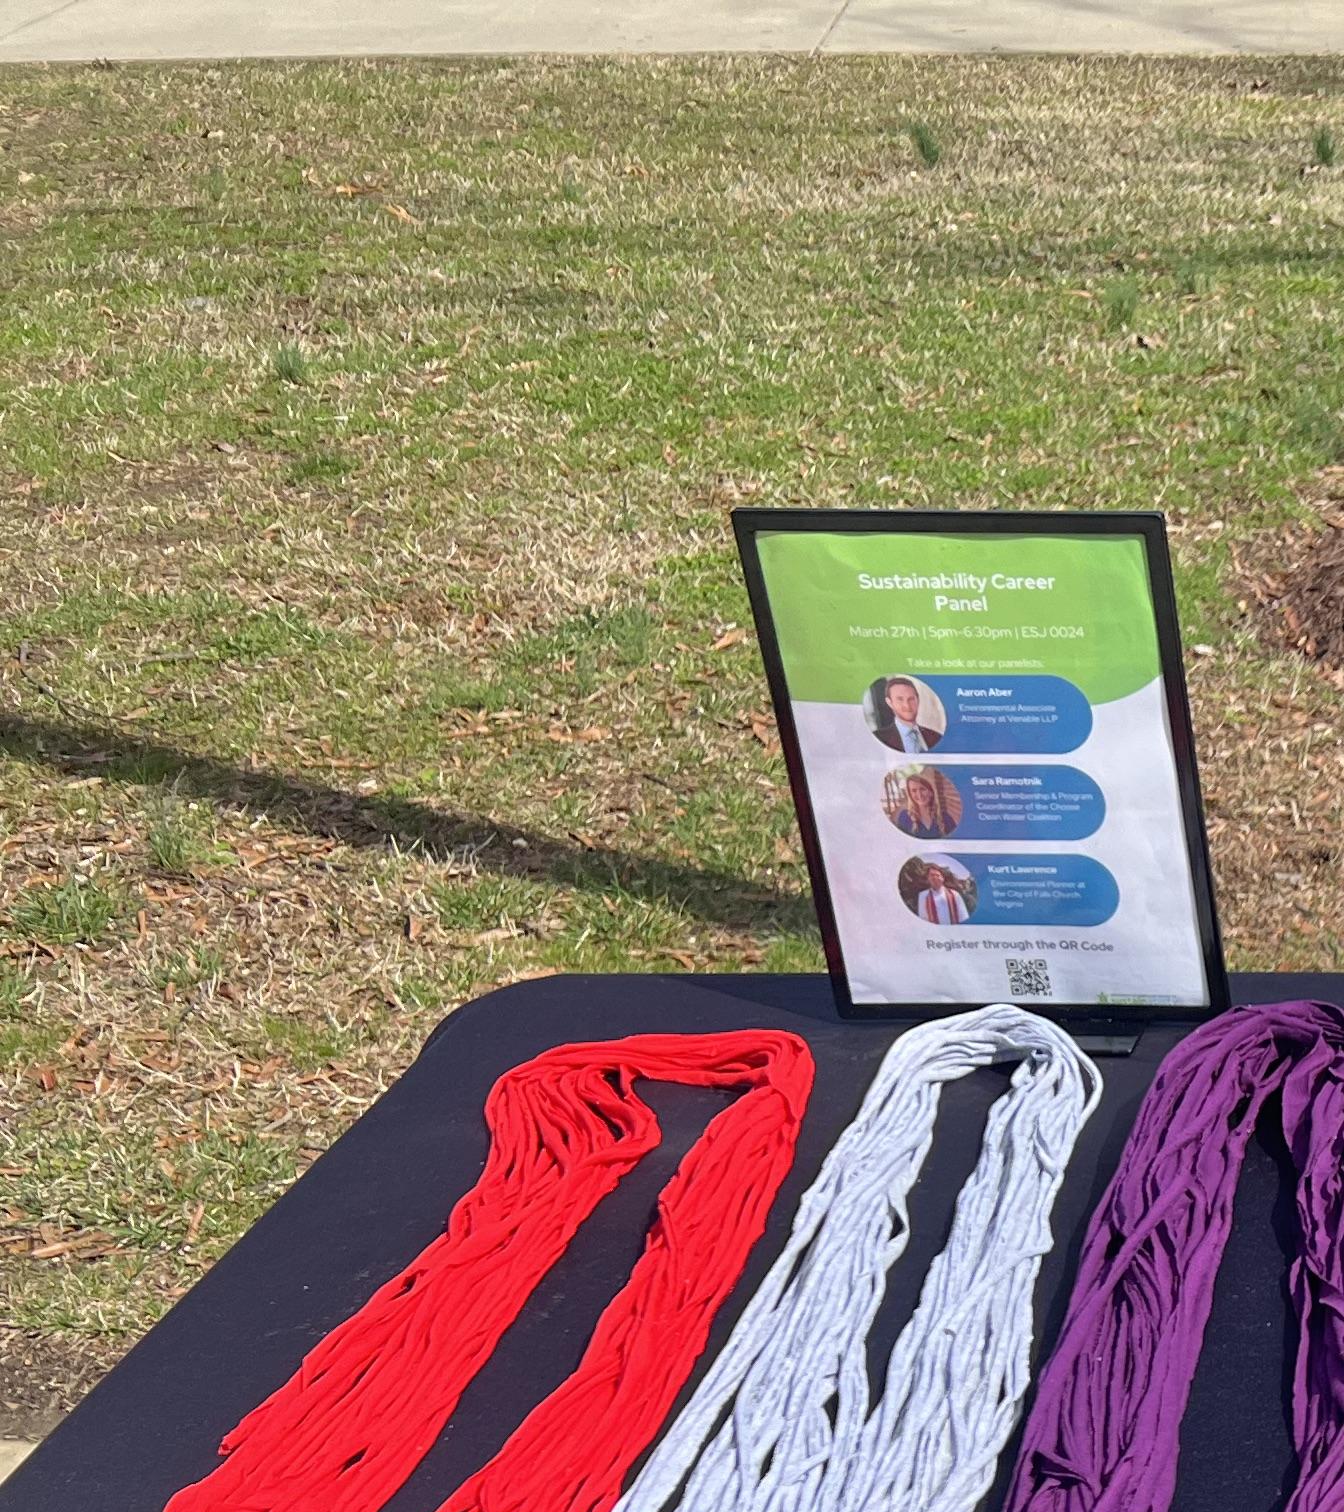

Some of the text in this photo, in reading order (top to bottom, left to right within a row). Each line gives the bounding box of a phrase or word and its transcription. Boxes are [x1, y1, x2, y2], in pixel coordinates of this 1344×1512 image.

[858, 573, 1055, 592] Sustainability Career
[934, 595, 988, 611] Panel
[849, 626, 888, 637] March
[891, 626, 919, 637] 27th
[1021, 626, 1048, 637] ESJ
[1052, 626, 1084, 638] 0024
[907, 658, 932, 668] Take
[942, 658, 967, 668] look
[956, 688, 1013, 697] Aaron Aber
[961, 715, 996, 724] Attorney
[971, 777, 994, 785] Sara
[926, 939, 1113, 952] Register through the QR Code
